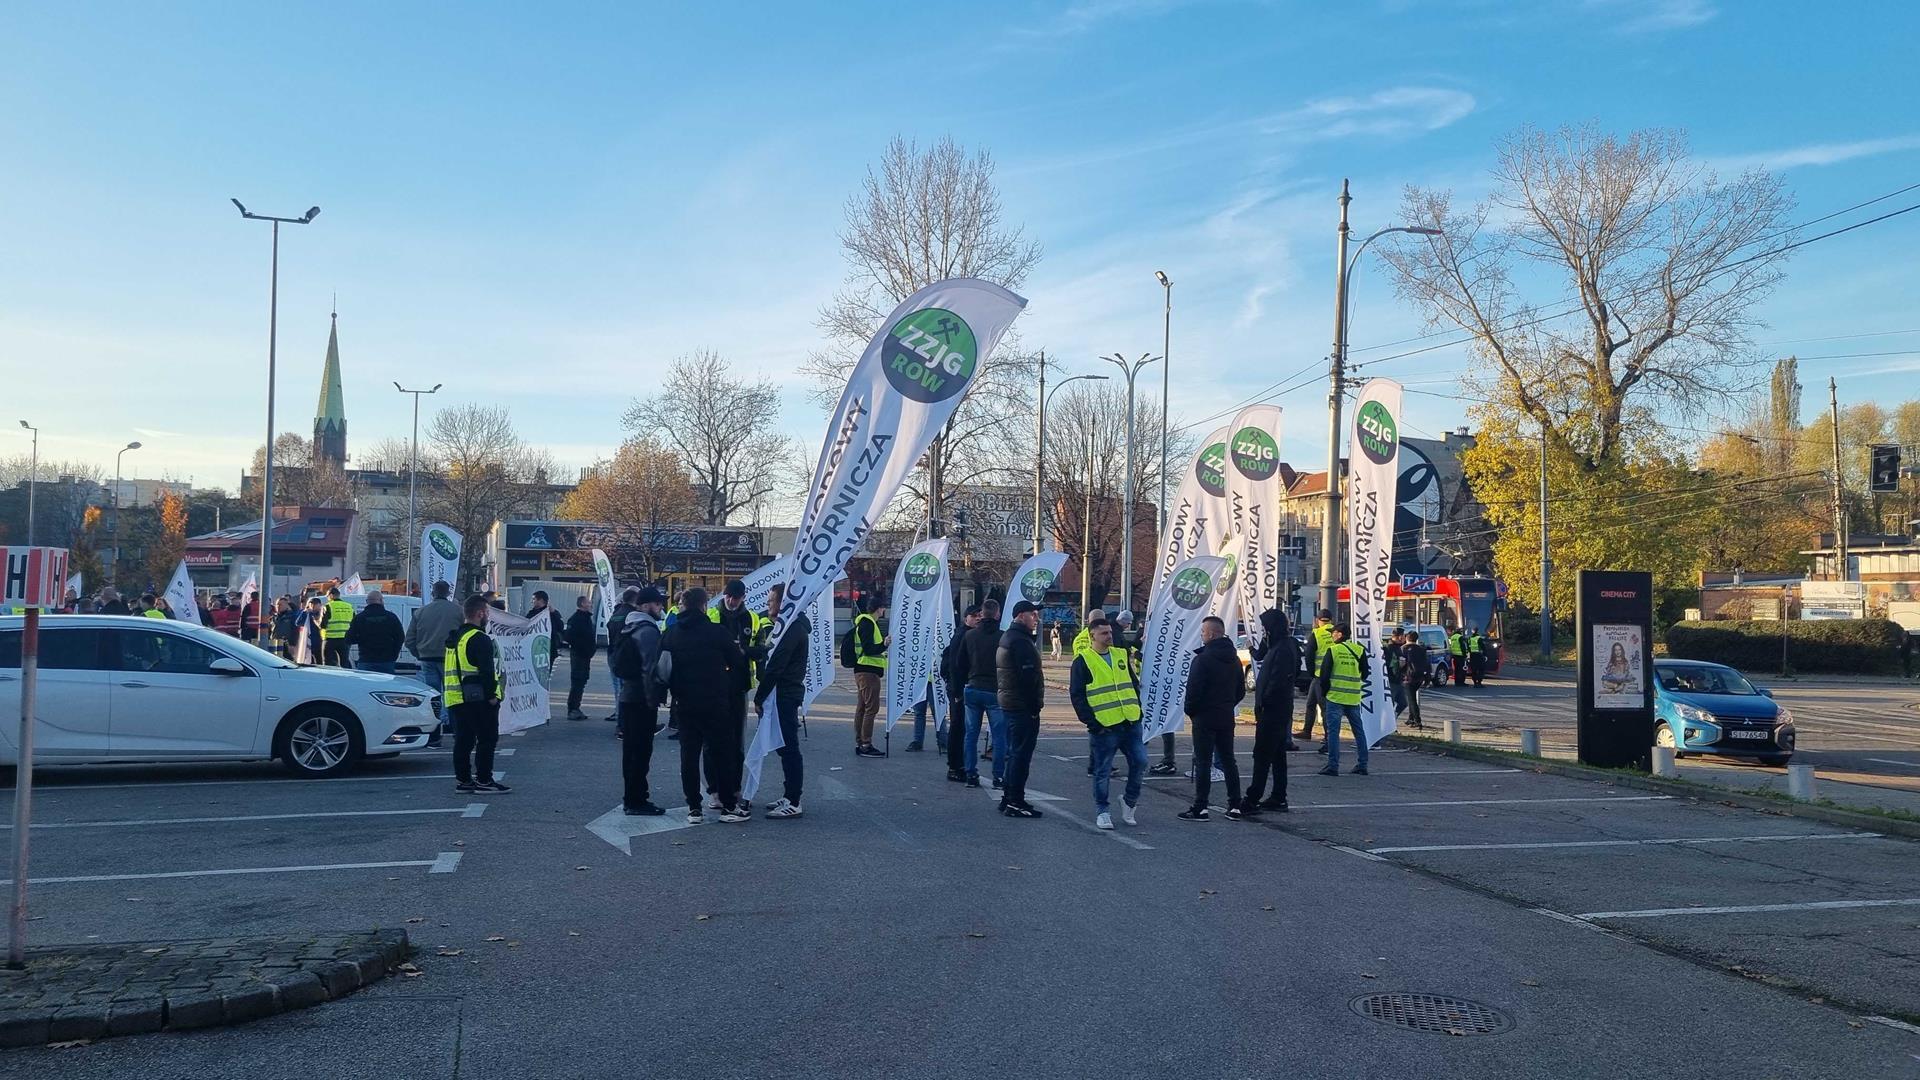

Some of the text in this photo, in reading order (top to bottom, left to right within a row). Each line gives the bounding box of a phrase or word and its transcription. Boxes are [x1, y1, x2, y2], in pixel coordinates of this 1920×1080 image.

[899, 325, 966, 376] ZZJG
[891, 353, 945, 393] ROW
[1362, 415, 1392, 443] ZZJG
[1363, 435, 1388, 457] ROW
[1237, 442, 1273, 461] ZZJG
[1240, 458, 1269, 473] ROW
[5, 555, 28, 599] H
[51, 556, 62, 600] H
[910, 564, 937, 576] ZZJG
[911, 577, 933, 585] ROW
[1026, 577, 1051, 590] ZZJG
[1177, 579, 1207, 595] ZZJG
[1264, 554, 1276, 600] ROW
[1373, 549, 1389, 602] ROW
[1405, 577, 1434, 590] TAXI
[1177, 592, 1201, 605] ROW
[912, 599, 923, 652] GÓRNICZA
[812, 648, 823, 687] JEDNOŚĆ
[896, 594, 910, 707] ZWIĄZEK ZAWODOWY
[1181, 650, 1192, 680] ROW
[1143, 608, 1174, 731] ZWIĄZEK ZAWODOWY
[1158, 618, 1186, 730] JEDNOŚĆ GÓRNICZA
